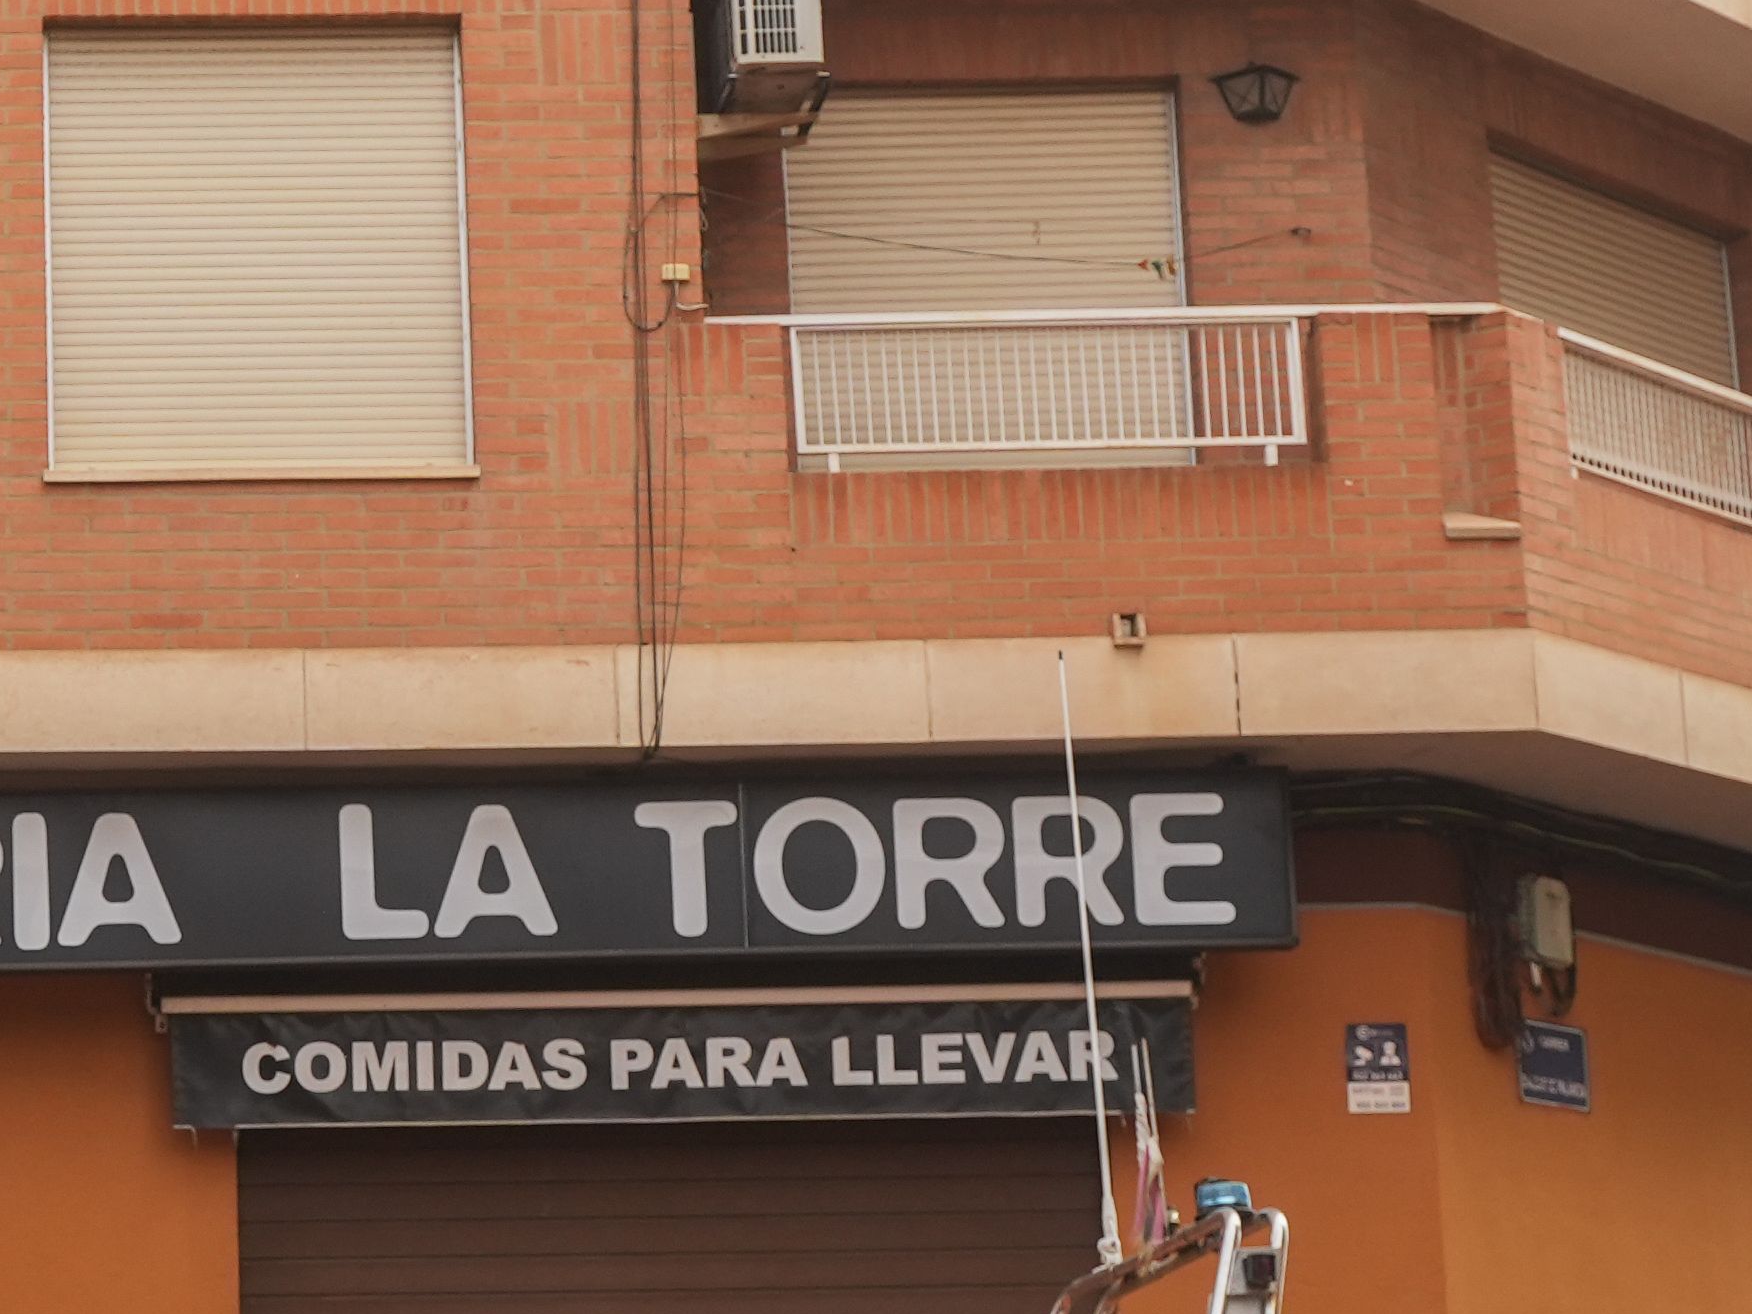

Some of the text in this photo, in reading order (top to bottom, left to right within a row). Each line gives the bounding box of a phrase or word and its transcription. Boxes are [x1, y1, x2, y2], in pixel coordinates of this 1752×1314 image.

[339, 804, 558, 940] LA
[634, 793, 1237, 937] TORRE
[242, 1030, 1120, 1094] COMIDAS PARA LLEVAR
